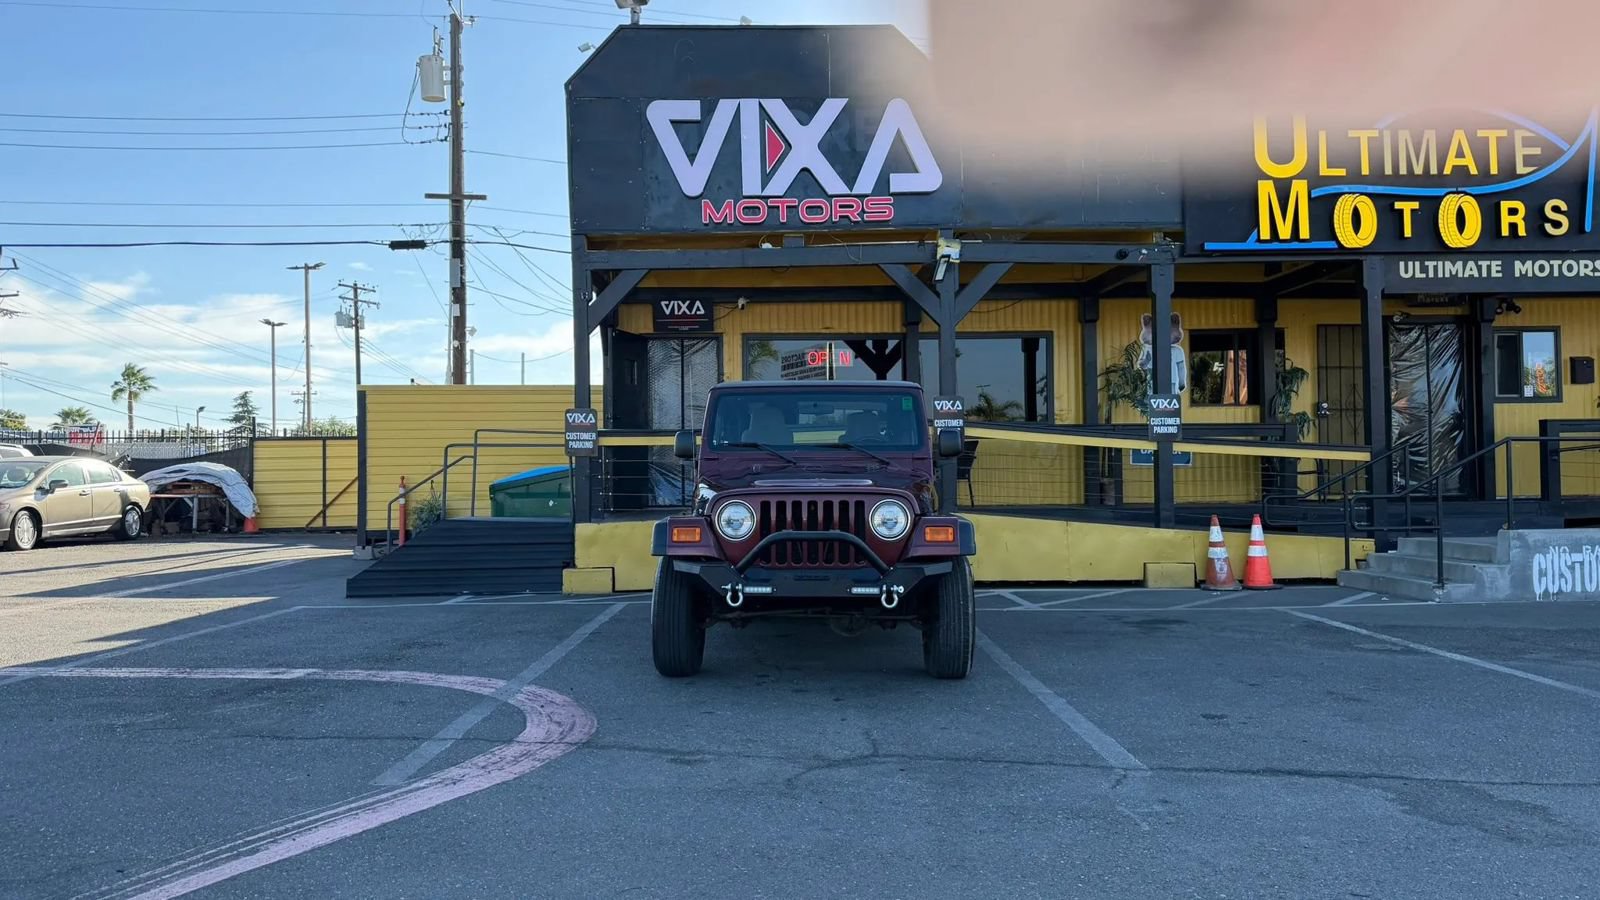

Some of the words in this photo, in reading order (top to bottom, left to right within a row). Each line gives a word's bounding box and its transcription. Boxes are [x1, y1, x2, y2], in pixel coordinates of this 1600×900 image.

[646, 98, 943, 197] VIXA
[1253, 114, 1542, 178] ULTIMATE
[701, 196, 894, 223] MOTORS
[1258, 179, 1569, 248] MOTORS
[1400, 260, 1503, 278] ULTIMATE
[660, 300, 705, 315] VIXA
[807, 351, 851, 366] OPN
[934, 400, 962, 410] VIXA
[1150, 398, 1179, 409] VIXA
[566, 413, 596, 423] VIXA
[934, 419, 964, 427] CUSTOMER
[1150, 417, 1180, 425] CUSTOMER
[566, 432, 597, 440] CUSTOMER
[1153, 426, 1177, 434] PARKING
[568, 441, 593, 449] PARKING
[1533, 553, 1600, 593] CUSTO
